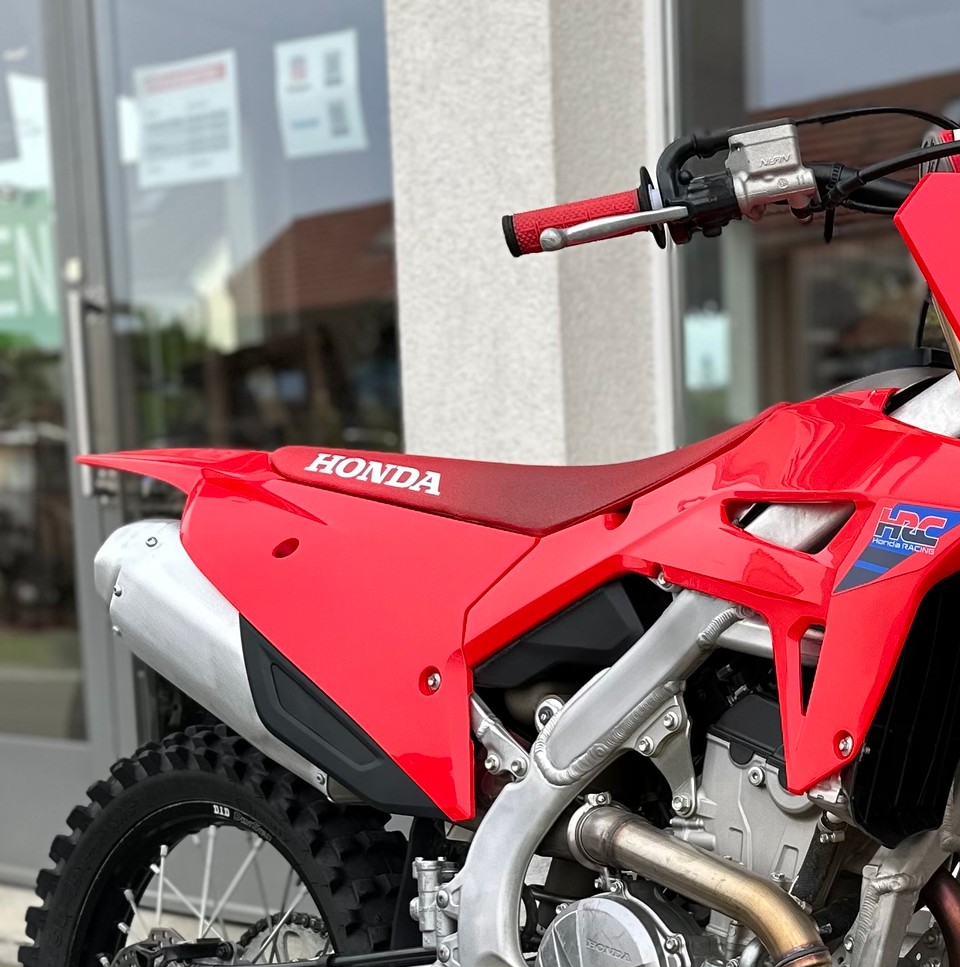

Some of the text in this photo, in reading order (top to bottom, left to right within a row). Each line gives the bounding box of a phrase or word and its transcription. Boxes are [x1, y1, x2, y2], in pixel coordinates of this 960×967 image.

[304, 453, 441, 496] HONDA
[873, 507, 948, 548] HRC
[871, 537, 936, 555] Honda RACING
[585, 938, 633, 963] HONDA
